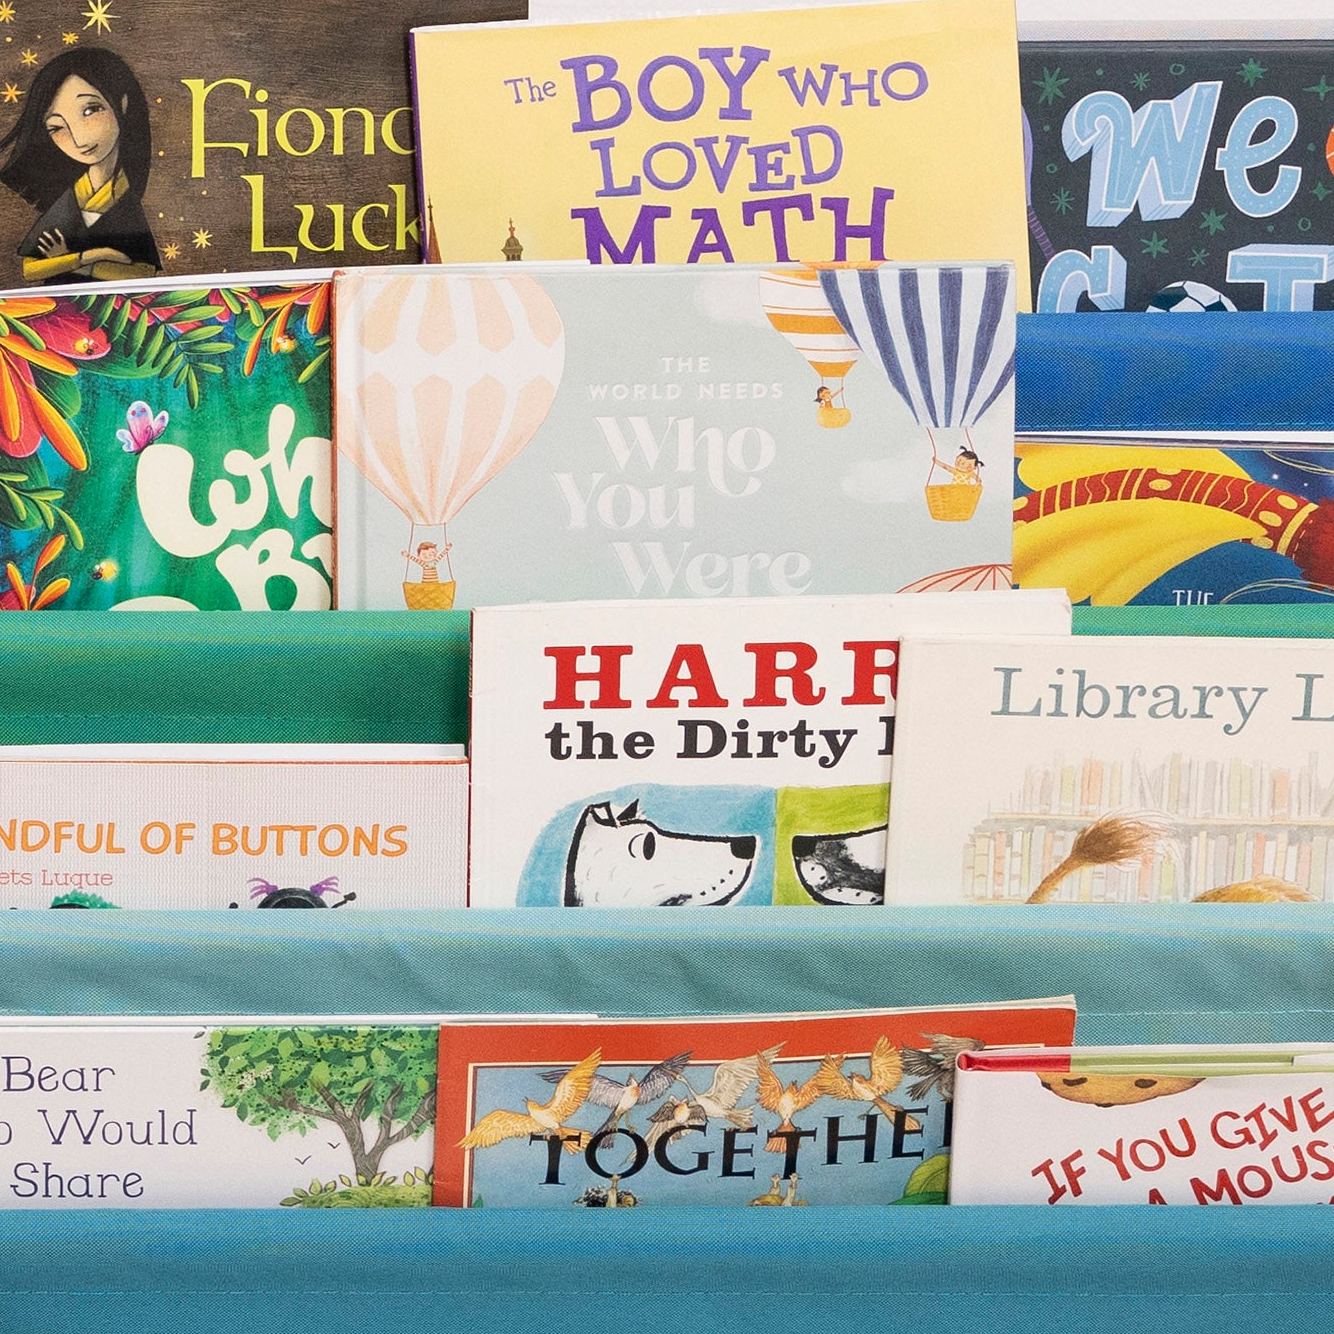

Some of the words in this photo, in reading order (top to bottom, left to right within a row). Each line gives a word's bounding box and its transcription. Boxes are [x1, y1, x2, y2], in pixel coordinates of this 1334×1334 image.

[503, 77, 557, 105] The
[560, 45, 770, 133] BOY
[777, 61, 928, 107] WHO
[589, 124, 843, 197] LOVED
[1061, 80, 1302, 227] We
[240, 174, 421, 263] Luck
[570, 187, 894, 264] MATH
[589, 383, 683, 401] WORLD
[698, 382, 785, 399] NEEDS
[661, 356, 711, 373] THE
[594, 415, 777, 497] Who
[550, 471, 696, 530] You
[607, 541, 813, 596] Were
[991, 667, 1267, 735] Library
[544, 721, 655, 760] the
[676, 719, 858, 768] Dirty
[139, 821, 195, 855] OF
[211, 823, 408, 857] BUTTONS
[41, 869, 114, 889] Luque
[2, 1056, 116, 1093] Bear
[39, 1109, 198, 1146] Would
[529, 1099, 952, 1185] TOGETHE
[10, 1163, 144, 1198] Share
[1031, 1149, 1088, 1204] IF
[1097, 1118, 1197, 1181] YOU
